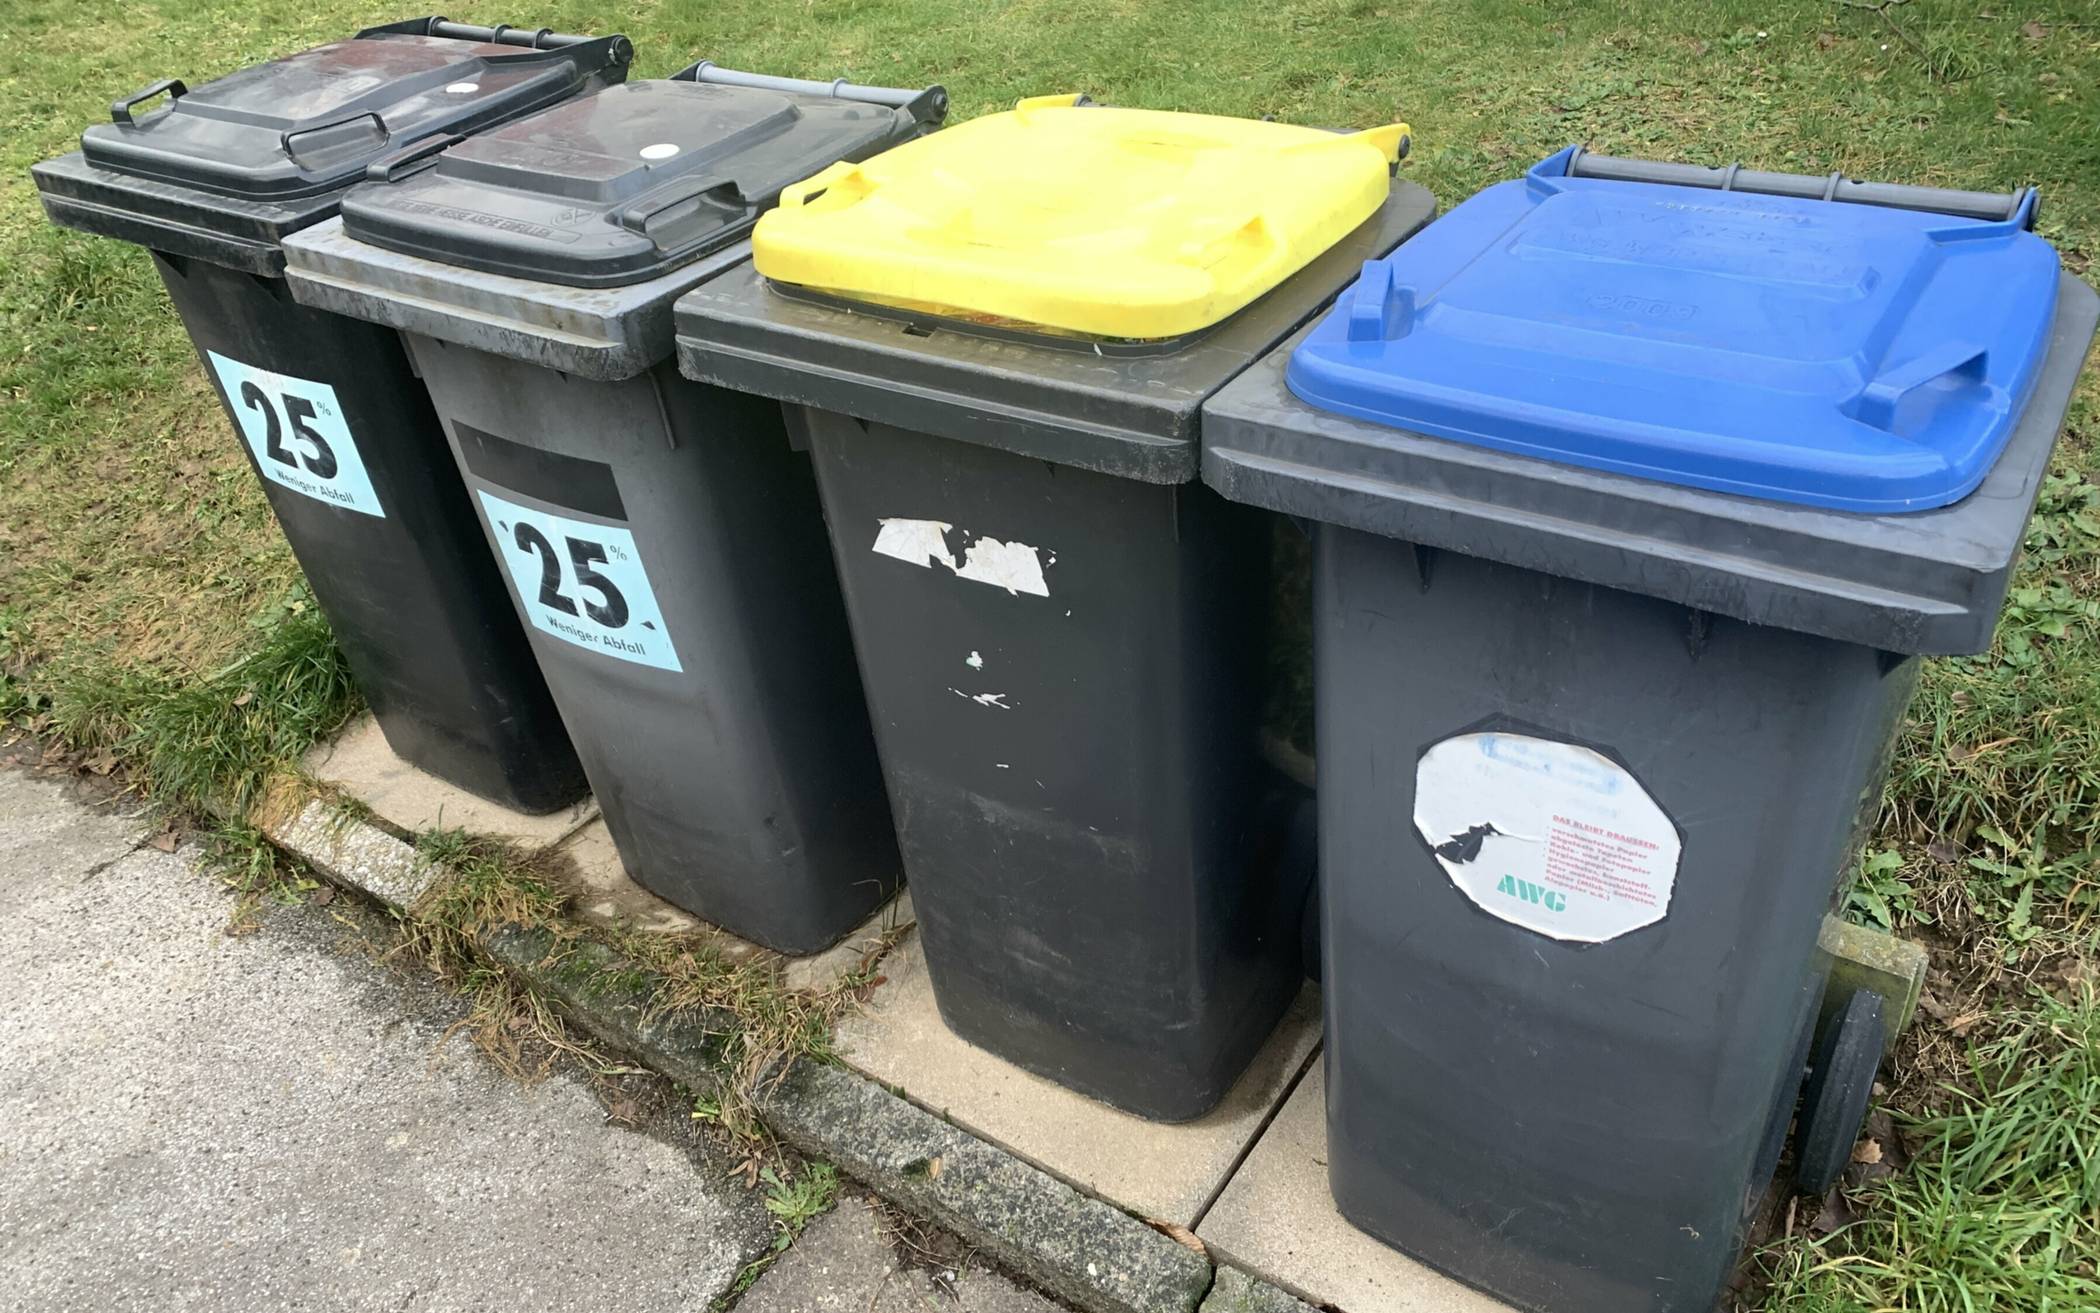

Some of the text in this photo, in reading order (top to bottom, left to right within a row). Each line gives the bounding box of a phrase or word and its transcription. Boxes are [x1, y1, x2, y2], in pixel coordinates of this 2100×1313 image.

[240, 380, 338, 480] 25
[275, 469, 355, 505] Weniger Abfall
[513, 521, 629, 629] 25
[546, 614, 647, 656] Weniger Abfall
[1552, 814, 1660, 851] DAS BLEIBT DRAUSSEN:
[1548, 848, 1615, 873] Hygienepapier
[1582, 851, 1600, 861] und
[1601, 857, 1652, 875] Fotopapier
[1597, 848, 1634, 864] Tapeten
[1616, 845, 1648, 859] Papier
[1545, 868, 1575, 883] Papier
[1546, 863, 1567, 873] oder
[1496, 874, 1567, 913] AWG
